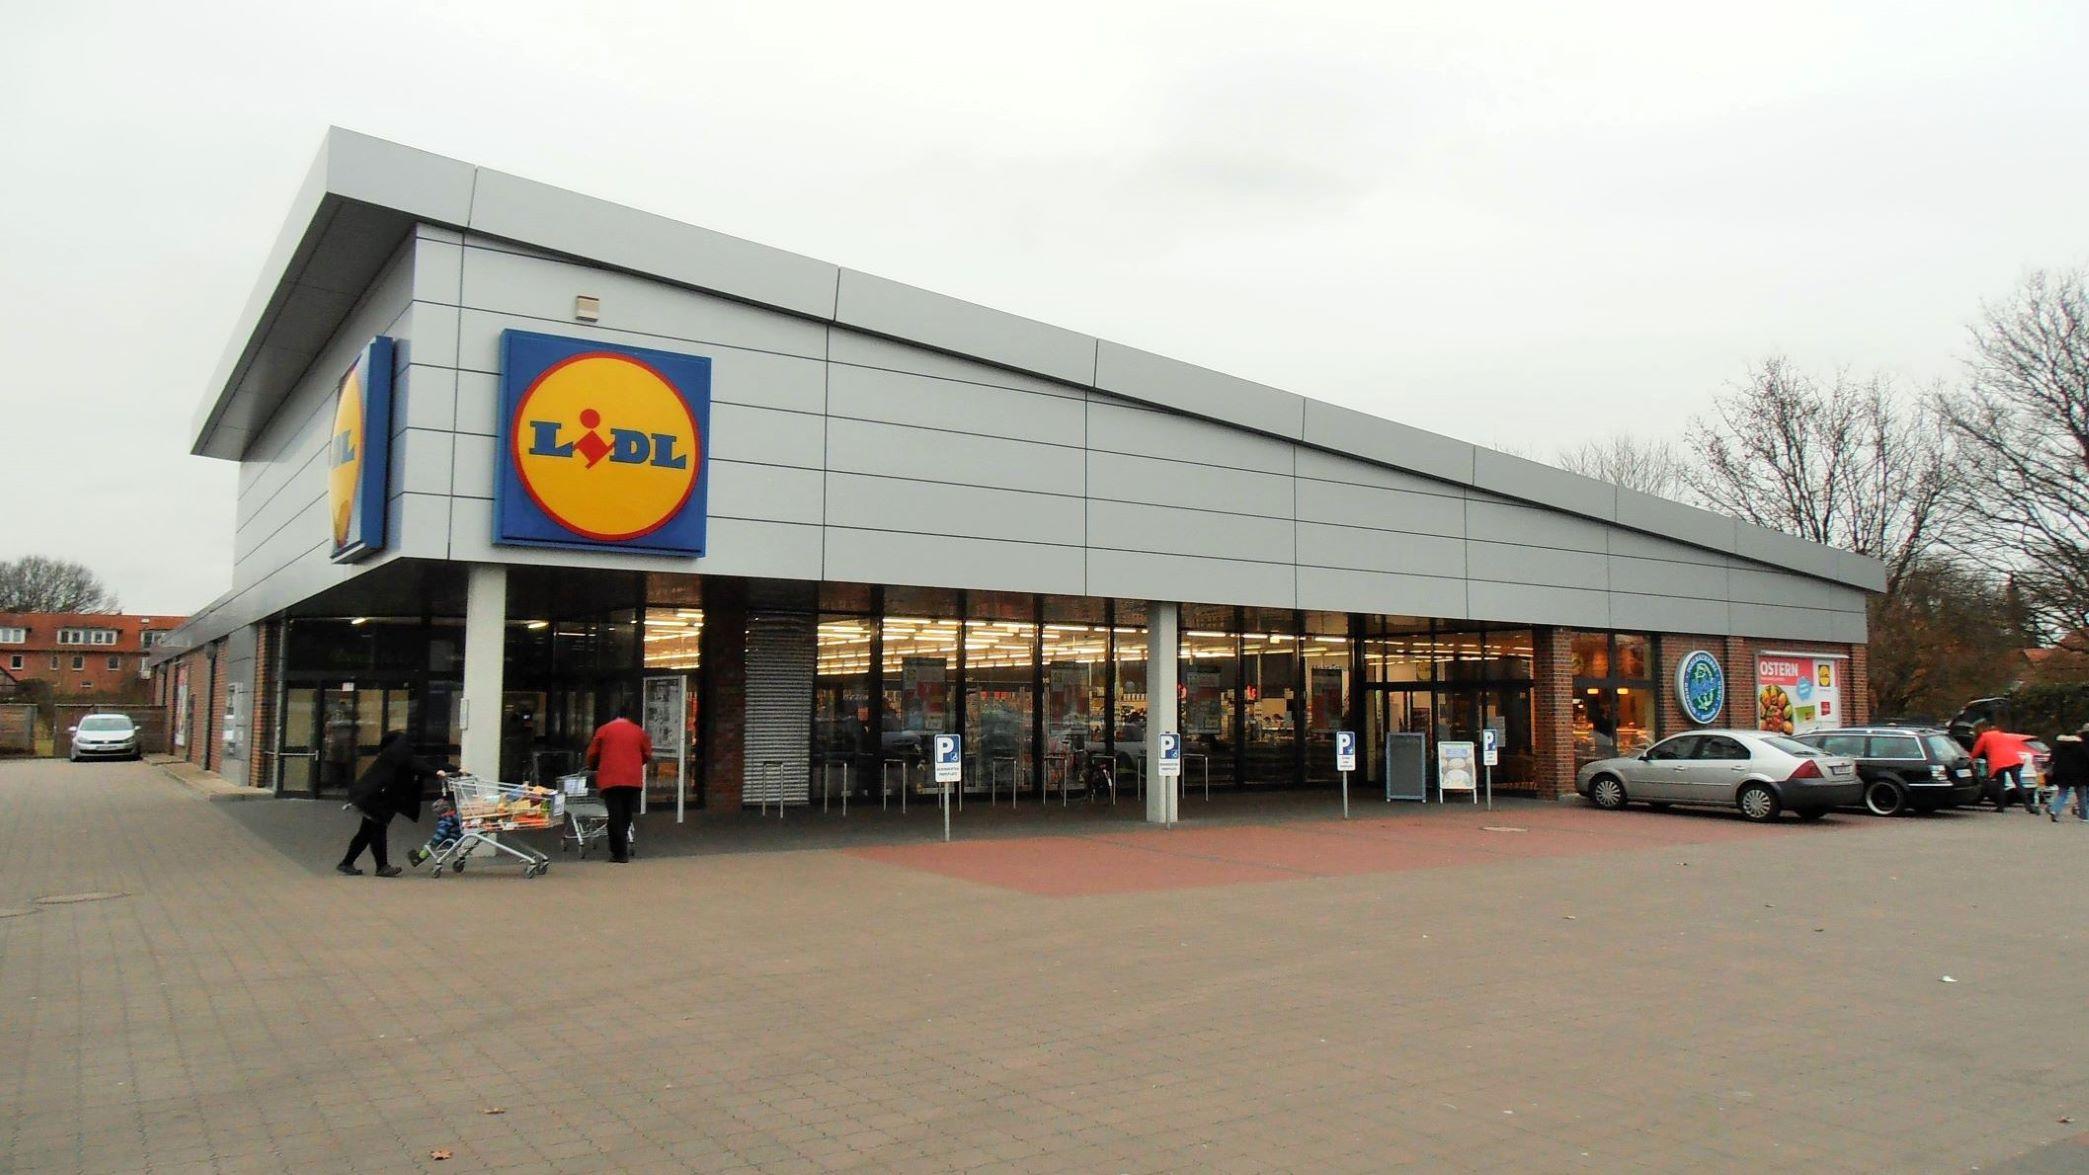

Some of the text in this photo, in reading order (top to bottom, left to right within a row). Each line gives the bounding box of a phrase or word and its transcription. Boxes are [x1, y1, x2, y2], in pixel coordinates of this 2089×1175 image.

[1760, 660, 1799, 677] OSTERN
[937, 737, 954, 763] P
[1160, 735, 1175, 759] P
[1338, 733, 1351, 755] P
[1483, 731, 1494, 751] P
